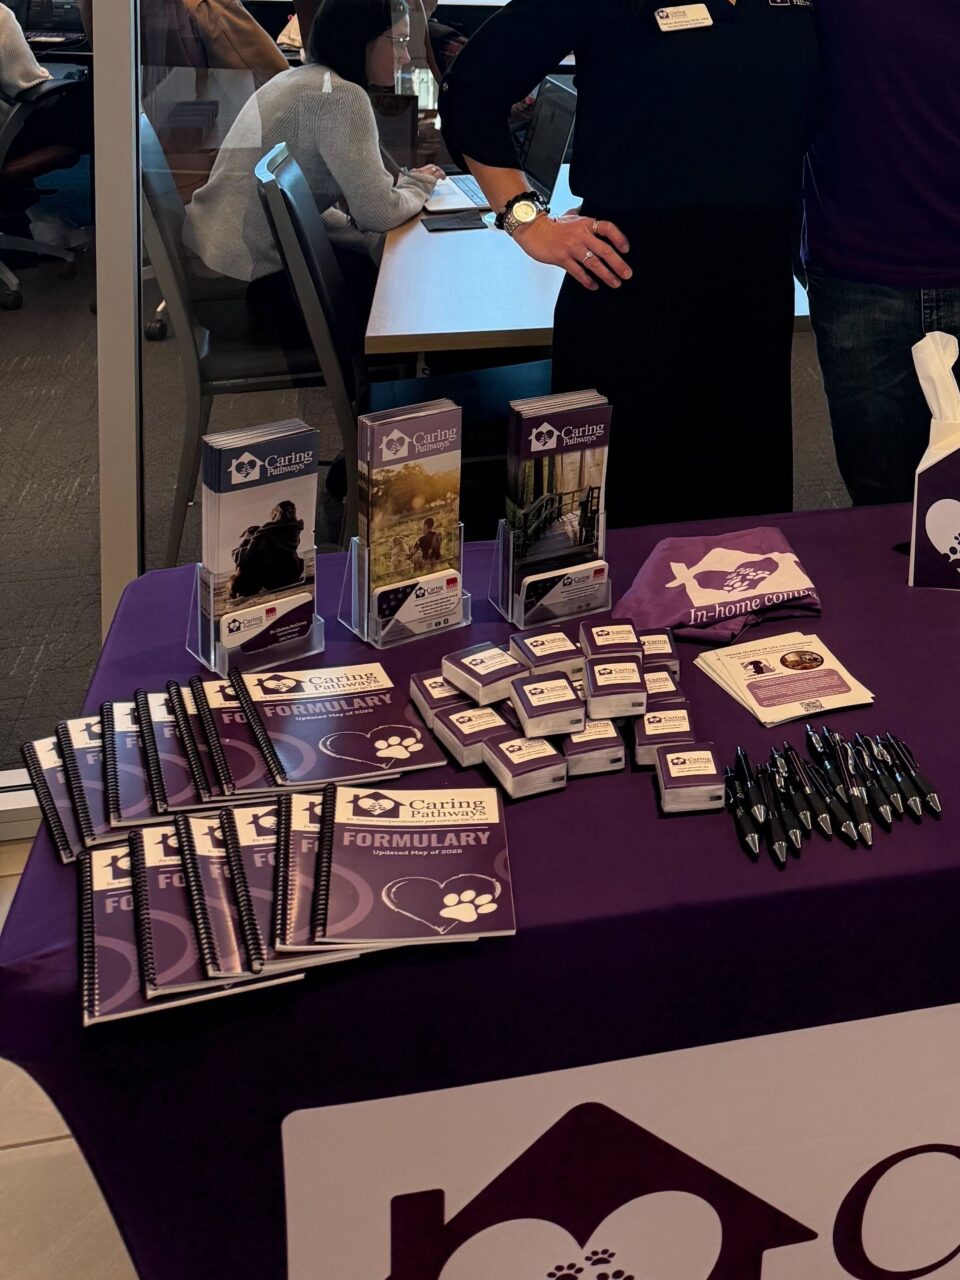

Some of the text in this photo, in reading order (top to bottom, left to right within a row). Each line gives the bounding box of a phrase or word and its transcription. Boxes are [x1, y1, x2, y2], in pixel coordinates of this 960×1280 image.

[412, 428, 458, 446] Caring
[562, 422, 605, 439] Caring
[414, 440, 450, 454] Pathways
[562, 434, 597, 446] Pathways
[264, 451, 314, 469] Caring
[267, 462, 306, 477] Pathways
[689, 598, 761, 625] In-home
[309, 672, 377, 685] Caring
[314, 679, 381, 691] Pathways
[263, 693, 392, 718] FORMULARY
[409, 798, 486, 811] Caring
[411, 809, 487, 819] Pathways
[343, 831, 491, 848] FORMULARY
